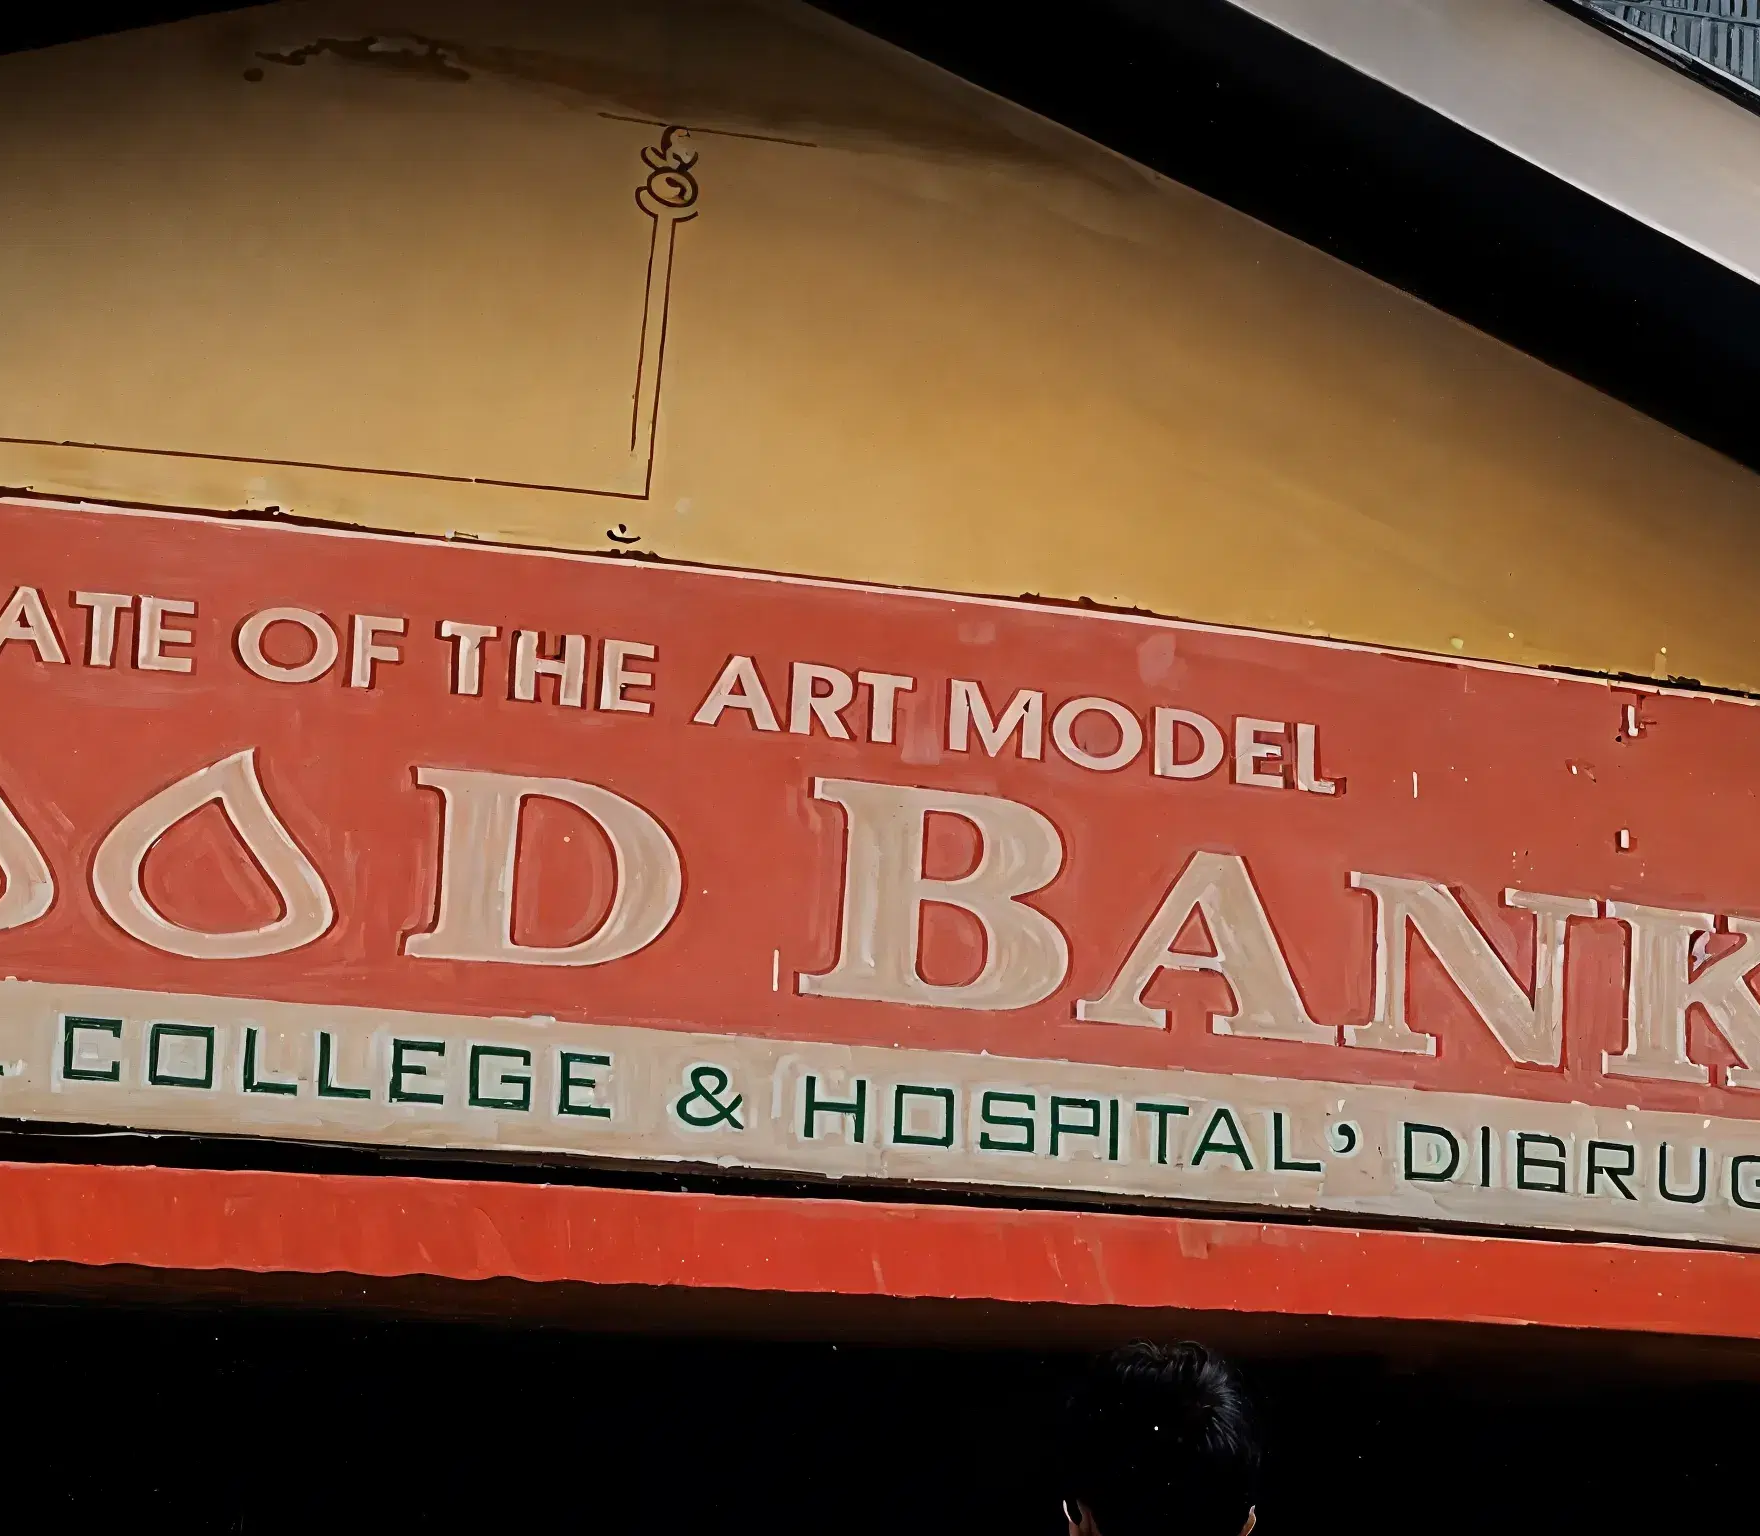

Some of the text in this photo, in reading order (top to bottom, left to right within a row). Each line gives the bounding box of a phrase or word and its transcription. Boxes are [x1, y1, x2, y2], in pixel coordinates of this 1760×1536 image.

[237, 606, 407, 690] OF
[438, 622, 656, 714] THE
[692, 654, 914, 744] ART
[946, 680, 1344, 794] MODEL
[62, 1015, 613, 1118] COLLEGE
[675, 1064, 744, 1128] &
